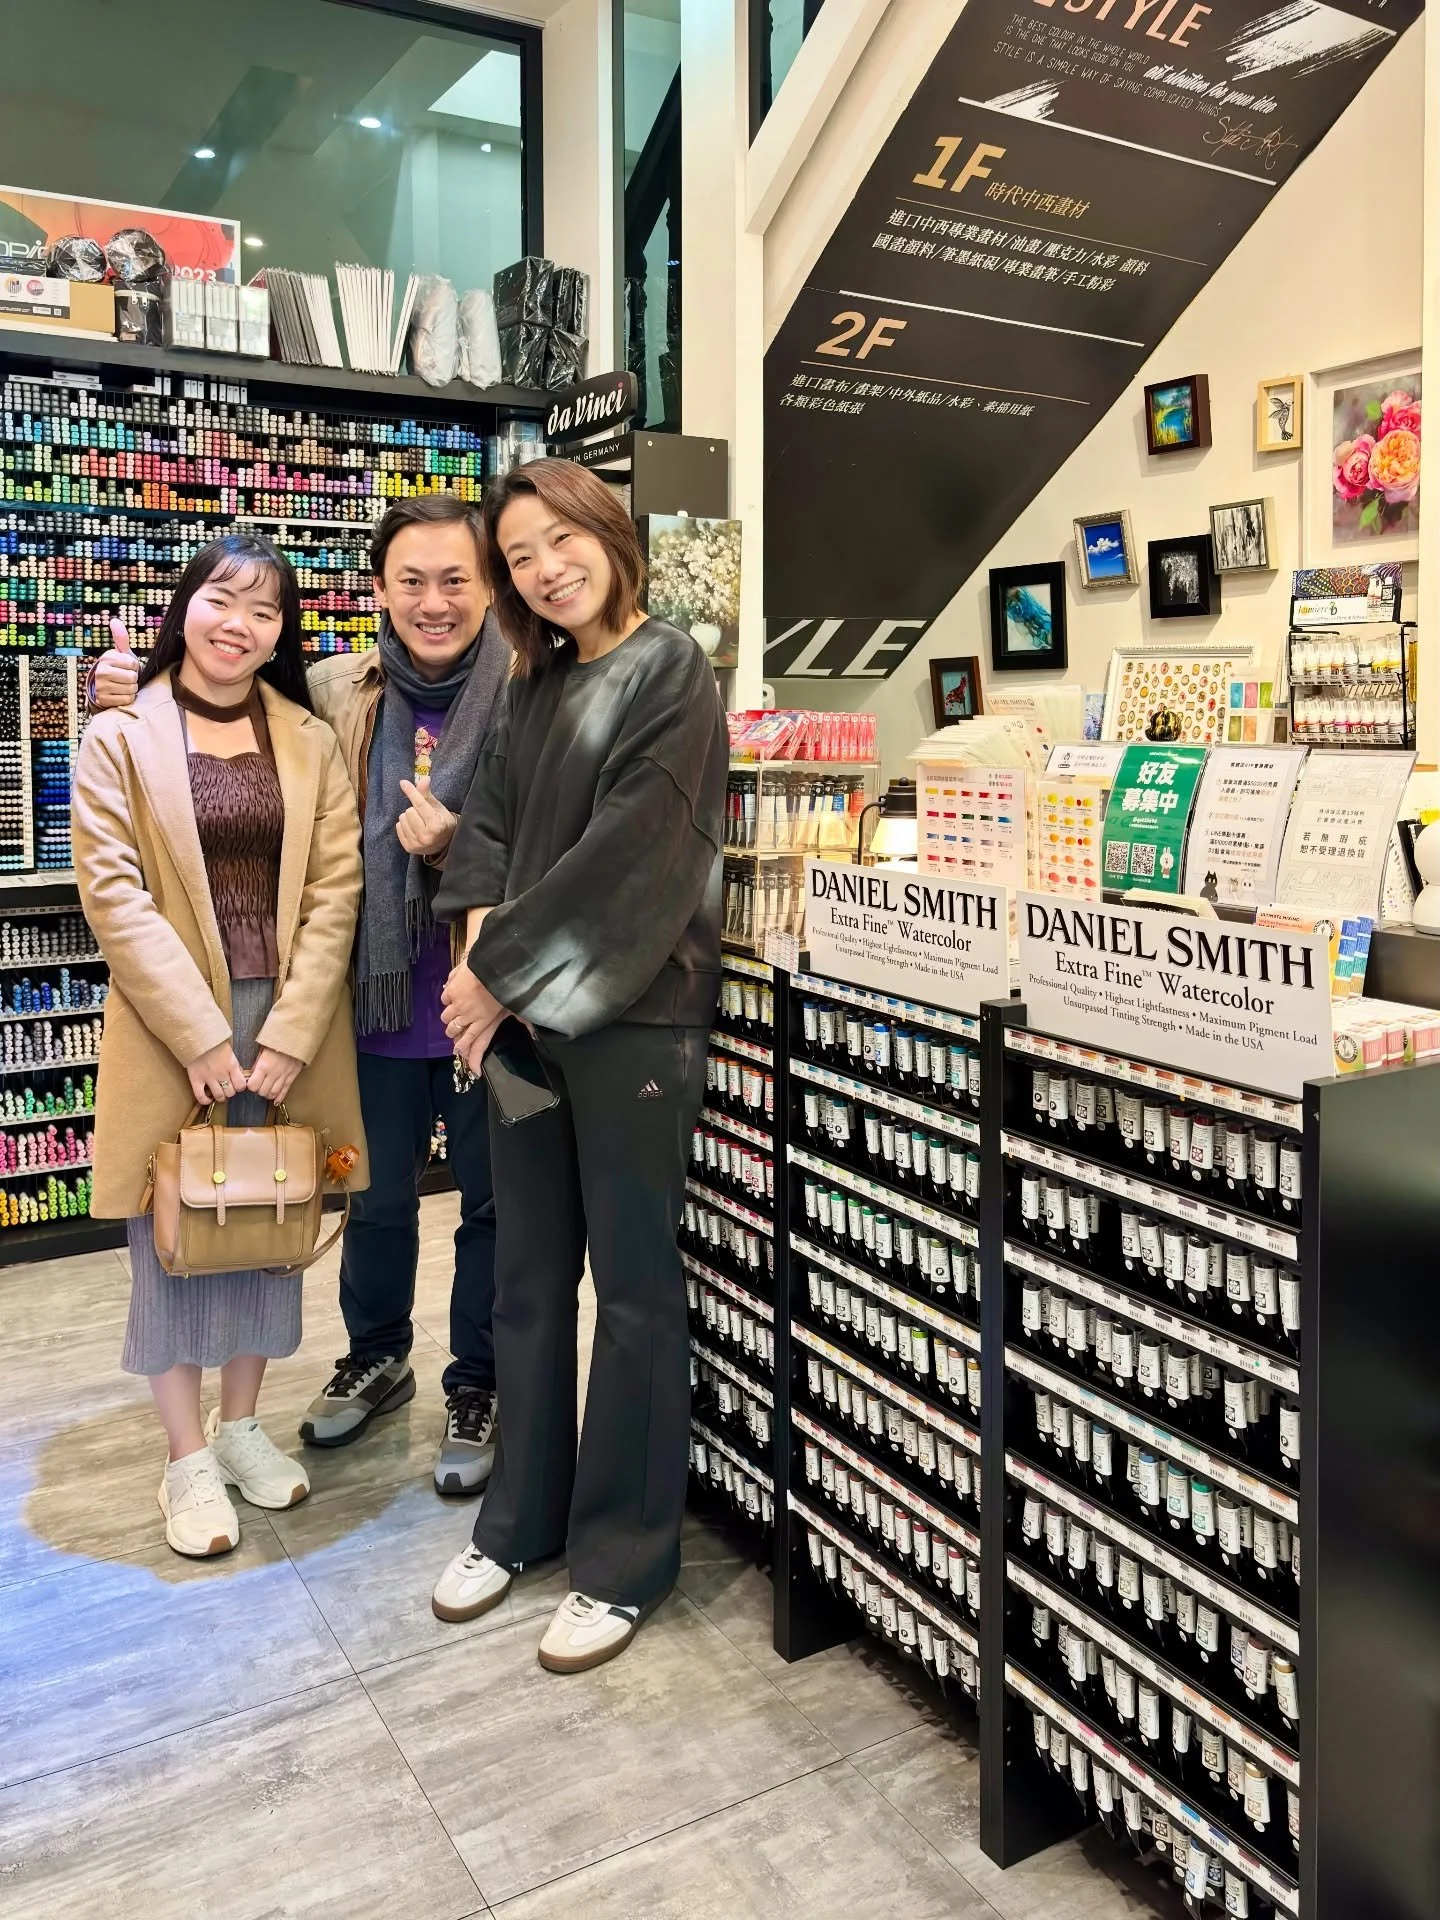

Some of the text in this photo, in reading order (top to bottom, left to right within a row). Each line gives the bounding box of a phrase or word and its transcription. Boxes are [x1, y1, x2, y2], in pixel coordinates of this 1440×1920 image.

[1011, 14, 1026, 25] THE
[1028, 18, 1046, 31] BEST
[1048, 23, 1075, 40] COLOUR
[1087, 36, 1103, 50] THE
[1103, 42, 1127, 58] WHOLE
[1128, 49, 1151, 64] WORLD
[1014, 29, 1029, 42] THE
[1031, 32, 1046, 46] ONE
[1048, 38, 1066, 53] THAT
[1067, 44, 1091, 60] LOOKS
[1090, 51, 1109, 65] GOOD
[1109, 57, 1121, 70] ON
[1122, 61, 1137, 73] YOU
[993, 41, 1021, 60] STYLE
[1024, 48, 1035, 63] IS
[1046, 57, 1078, 77] SIMPLE
[1080, 66, 1098, 81] WAY
[1099, 72, 1112, 85] OF
[1113, 76, 1144, 96] SAYING
[1143, 86, 1194, 110] COMPLICATED
[1195, 100, 1224, 118] THINGS
[912, 135, 1090, 221] 1F 時代中西畫材
[1117, 256, 1151, 277] 顏料
[815, 311, 907, 360] 2F
[779, 393, 867, 415] 各類彩色紙張
[572, 454, 581, 464] IN
[583, 442, 621, 462] GERMANY
[1137, 761, 1179, 785] 好友
[1122, 788, 1179, 814] 募集中
[1300, 845, 1366, 859] 恕不受理退換貨
[811, 868, 998, 931] DANIEL SMITH
[812, 926, 839, 941] Professional
[840, 932, 858, 945] Quality
[862, 937, 883, 951] Highest
[883, 940, 918, 958] Lightfastness
[923, 950, 954, 966] Maximum
[955, 957, 980, 973] Pigment
[982, 962, 999, 975] Load
[831, 907, 859, 930] Extra
[897, 920, 972, 952] Watercolor
[1026, 902, 1316, 991] DANIEL SMITH
[835, 944, 865, 959] Unsurpassed
[866, 950, 885, 966] Tinting
[886, 953, 909, 970] Strength
[914, 961, 930, 975] Made
[939, 965, 949, 977] the
[949, 968, 965, 981] USA
[1055, 951, 1099, 981] Extra
[1157, 971, 1275, 1016] Watercolor
[1029, 973, 1319, 1047] Professional Quality Highest Lightfastness Maximum Pigment Load
[1063, 995, 1265, 1053] Unsurpassed Tinting Strength Made in the USA
[638, 1090, 663, 1098] adidas
